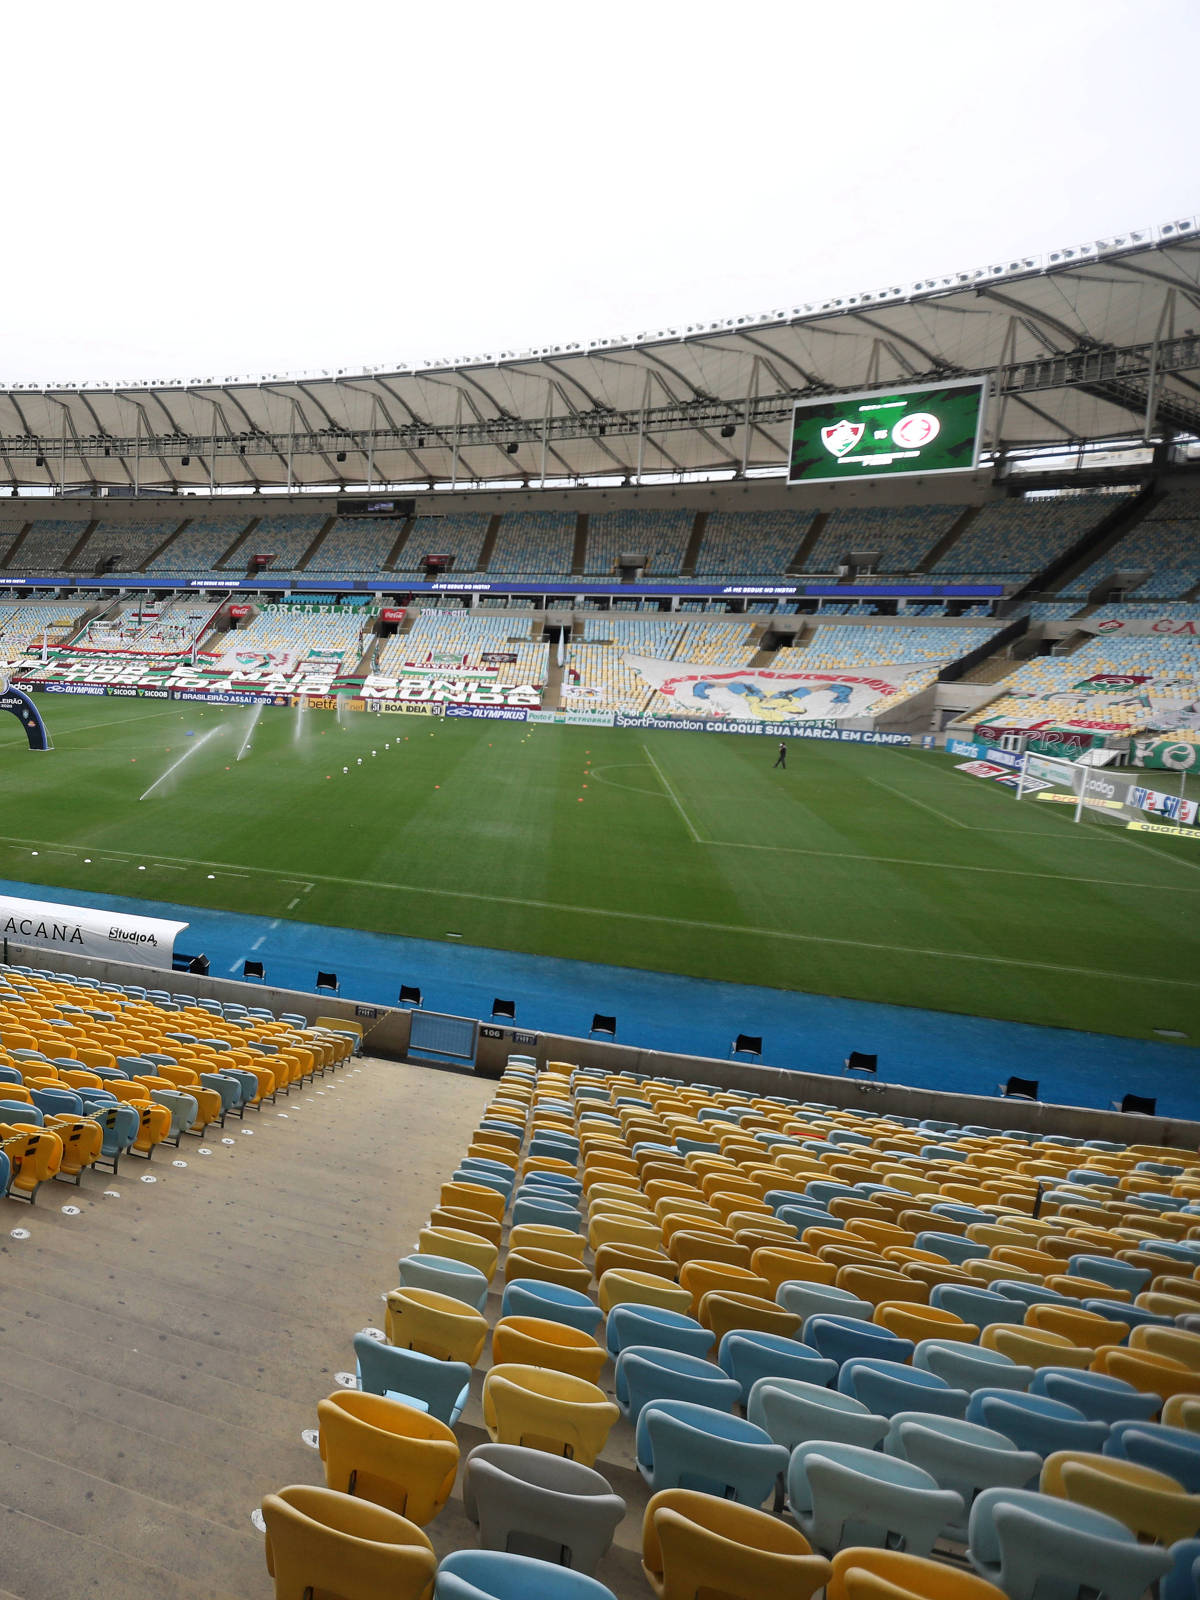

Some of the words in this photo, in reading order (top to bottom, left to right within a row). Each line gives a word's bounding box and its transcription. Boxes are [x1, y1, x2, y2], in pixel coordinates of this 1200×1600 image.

[228, 671, 337, 684] MAIS
[363, 675, 540, 695] BONITA
[63, 672, 232, 690] TORCIDA
[264, 682, 331, 695] DO
[360, 686, 541, 705] MUNDO
[65, 685, 104, 695] OLYMPIKUS
[114, 688, 137, 696] SICOOB
[144, 690, 168, 698] SICOOB
[183, 693, 229, 702] BRASILEIRÃO
[406, 705, 427, 713] IDEIA
[473, 709, 526, 720] OLYMPIKUS
[568, 716, 612, 724] PETROBRAS
[616, 716, 703, 730] SportPromotion
[706, 723, 762, 735] COLOQUE
[766, 726, 791, 736] SUA
[794, 727, 839, 740] MARCA
[841, 731, 861, 740] EM
[863, 732, 912, 744] CAMPO
[483, 1029, 500, 1038] 106
